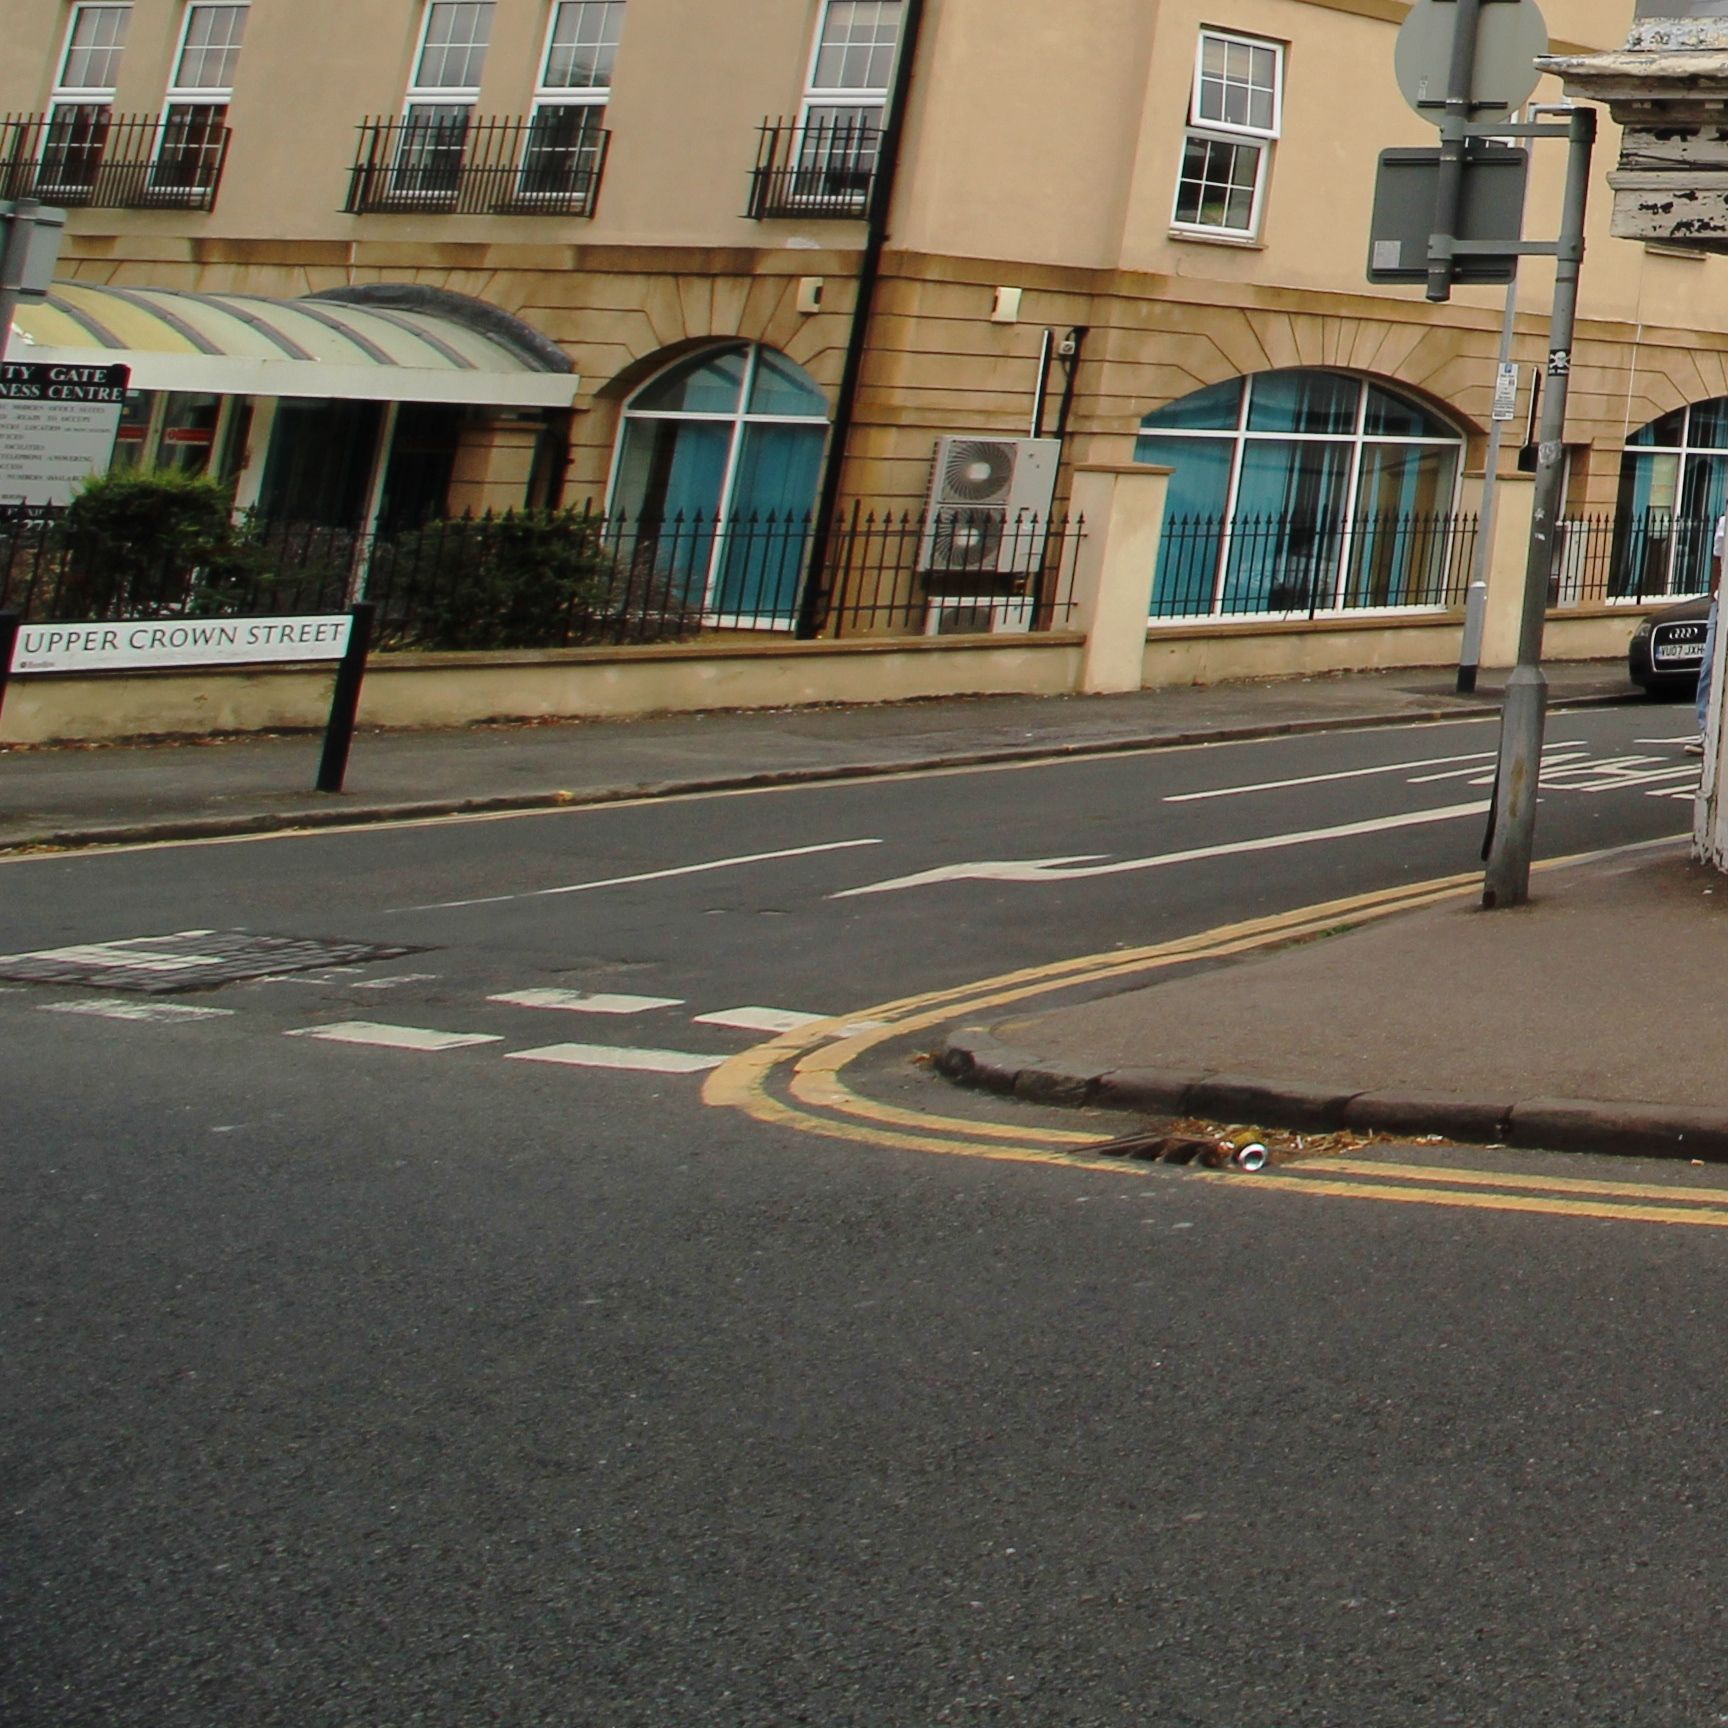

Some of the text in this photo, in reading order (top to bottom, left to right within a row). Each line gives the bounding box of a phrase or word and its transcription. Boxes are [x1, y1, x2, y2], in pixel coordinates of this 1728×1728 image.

[49, 367, 107, 383] GATE
[48, 384, 124, 401] CENTRE
[24, 622, 345, 654] UPPER CROWN STREET
